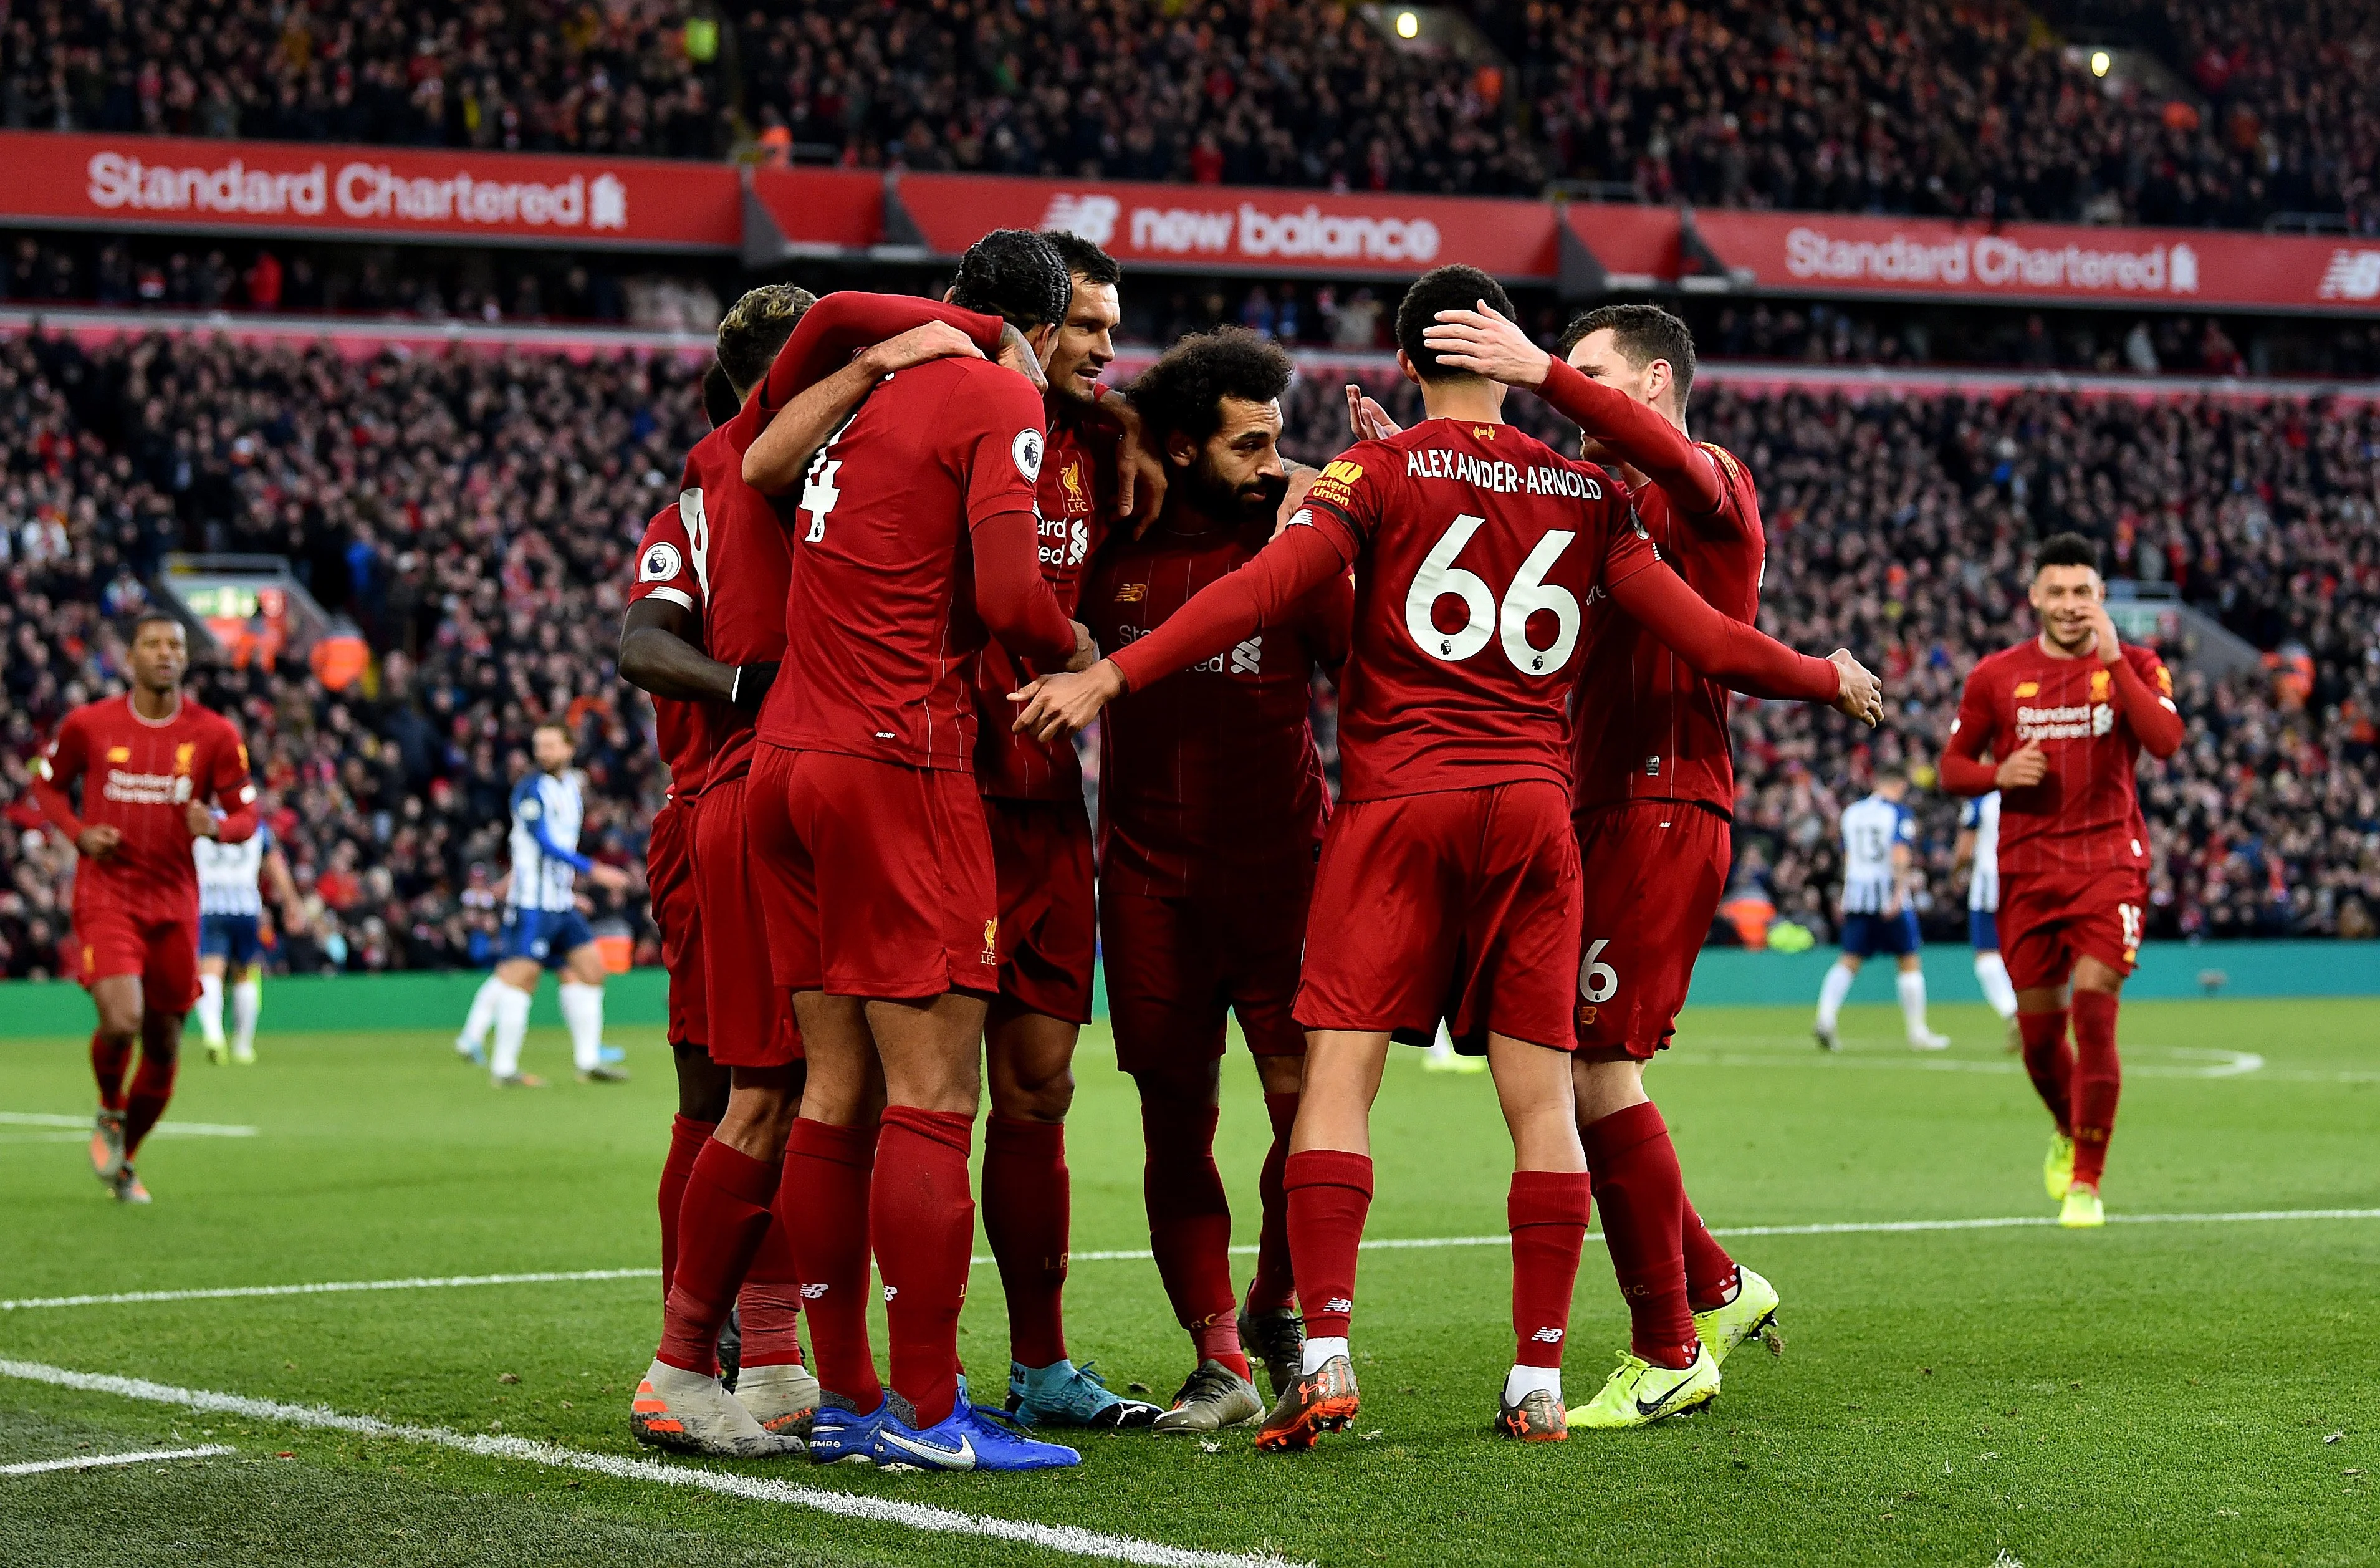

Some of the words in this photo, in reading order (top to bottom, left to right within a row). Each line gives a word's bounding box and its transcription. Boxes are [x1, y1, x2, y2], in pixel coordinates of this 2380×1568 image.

[88, 152, 325, 216] Standard
[335, 162, 585, 227] Chartered
[1130, 206, 1234, 253] new
[1239, 201, 1441, 262] balance
[1785, 228, 1969, 284] Standard
[1974, 235, 2166, 292] Chartered
[1312, 478, 1351, 496] estern
[1312, 487, 1350, 506] Union
[1406, 448, 1603, 501] ALEXANDER-ARNOLD
[1405, 514, 1580, 676] 66
[2016, 704, 2091, 724] Standard
